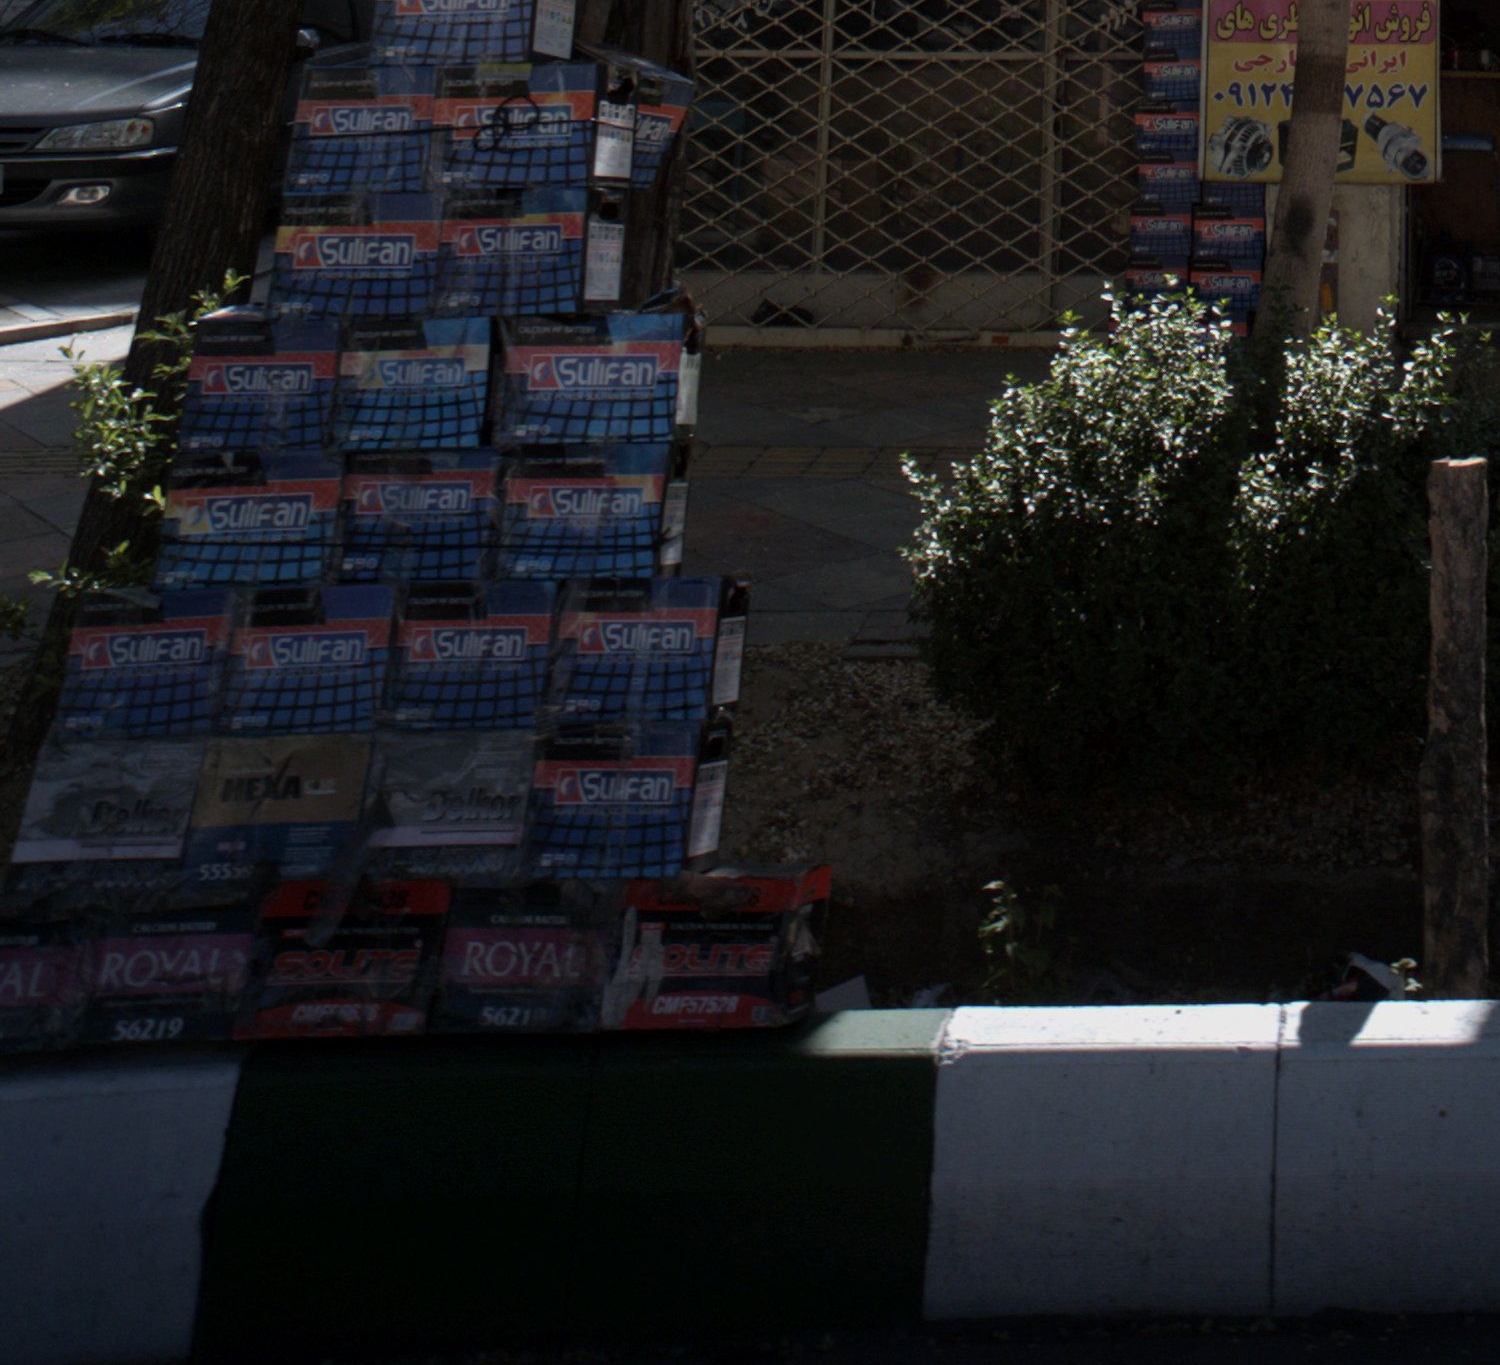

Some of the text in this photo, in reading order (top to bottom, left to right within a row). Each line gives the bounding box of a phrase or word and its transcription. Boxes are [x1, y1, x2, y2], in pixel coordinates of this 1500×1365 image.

[1216, 0, 1255, 41] های
[1375, 1, 1431, 42] فروش
[1235, 49, 1296, 73] ارجی
[98, 949, 224, 988] ROYAL
[462, 940, 581, 979] ROYAL
[111, 1017, 185, 1042] 56219
